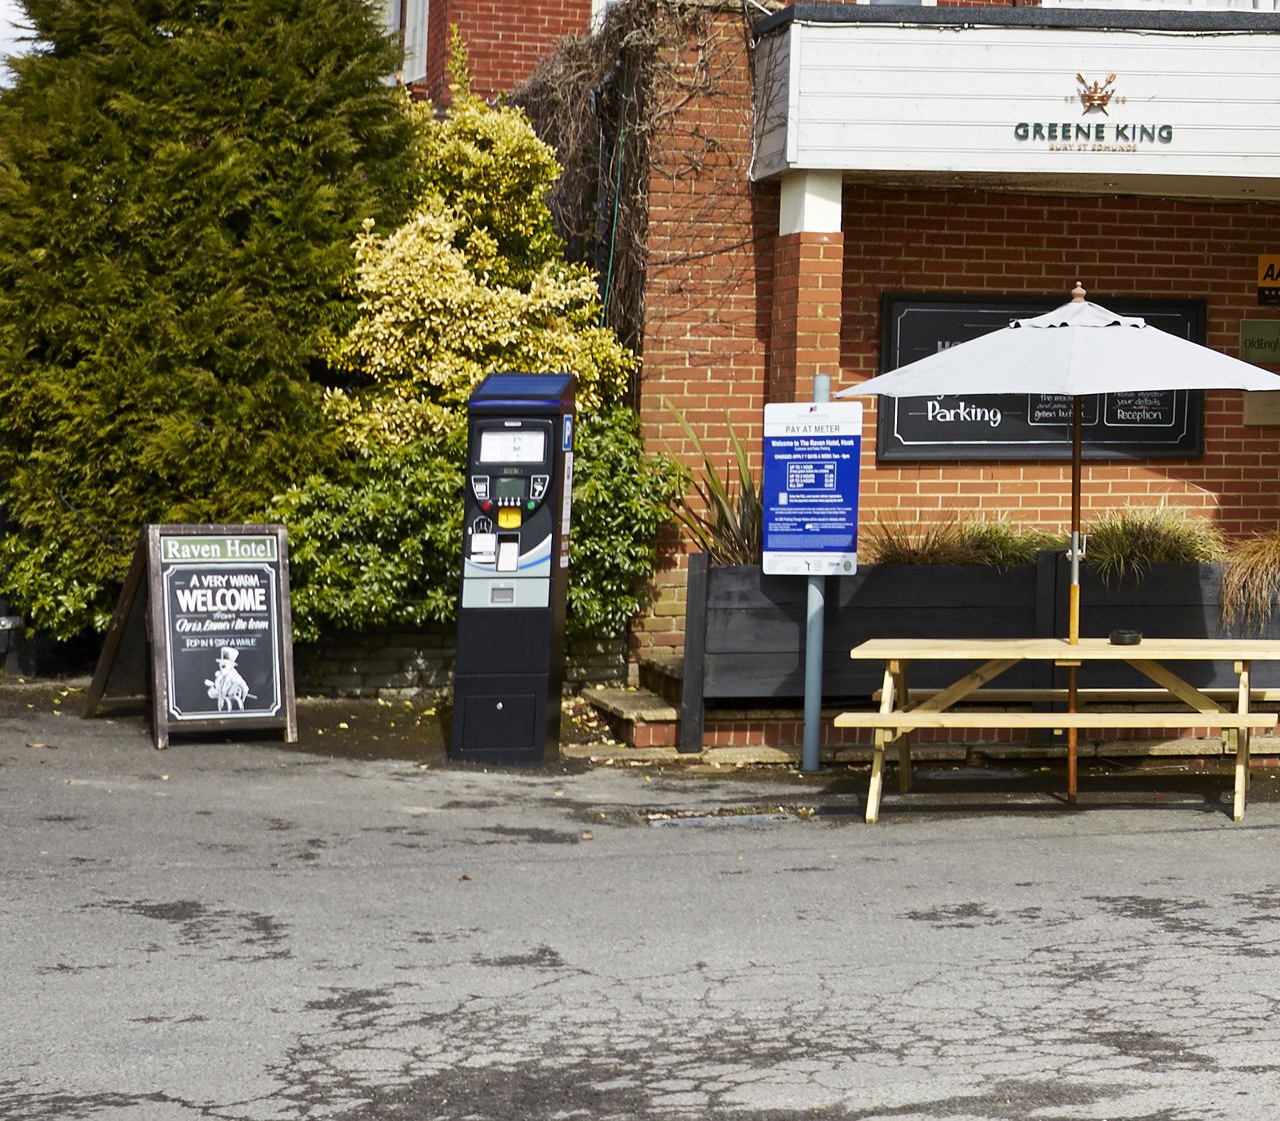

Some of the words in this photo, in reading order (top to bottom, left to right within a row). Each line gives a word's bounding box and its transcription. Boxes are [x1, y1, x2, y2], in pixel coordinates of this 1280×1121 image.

[1014, 123, 1106, 141] GREENE
[1115, 124, 1173, 144] KING
[1049, 143, 1073, 152] BURY
[1077, 143, 1088, 152] ST
[1091, 143, 1138, 153] EDMUNDS
[1117, 398, 1134, 406] your
[926, 400, 1002, 428] Parking
[1034, 410, 1056, 421] green
[1117, 408, 1162, 422] Reception
[785, 425, 800, 434] PAY
[802, 425, 812, 433] AT
[814, 424, 840, 434] METER
[167, 540, 221, 559] Raven
[226, 539, 272, 558] Hotel
[190, 574, 200, 588] A
[201, 574, 229, 588] VERY
[229, 574, 260, 588] WARM
[176, 588, 267, 612] WELCOME
